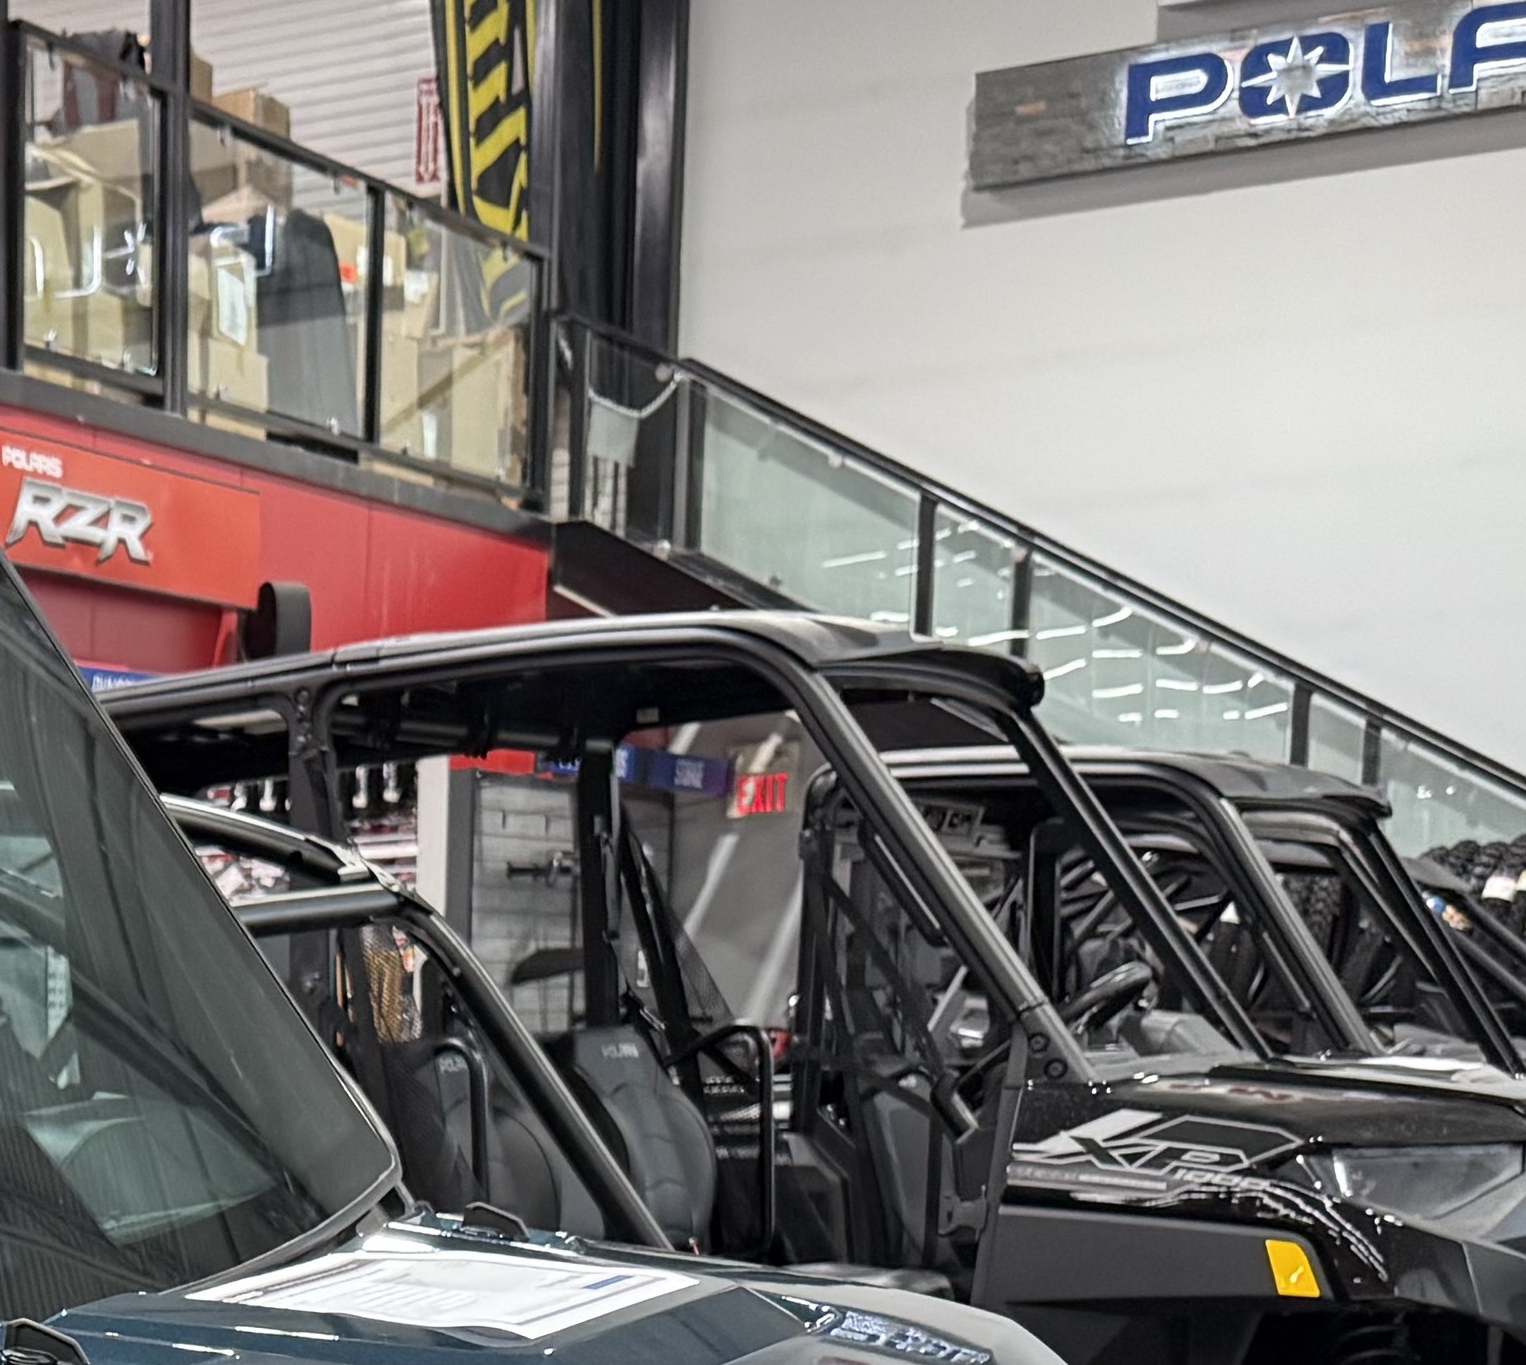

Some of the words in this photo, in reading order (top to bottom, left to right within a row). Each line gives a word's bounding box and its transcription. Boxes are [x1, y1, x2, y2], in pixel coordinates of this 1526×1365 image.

[1, 444, 64, 479] POLARIS
[6, 476, 153, 565] RZR
[736, 772, 789, 815] EXIT
